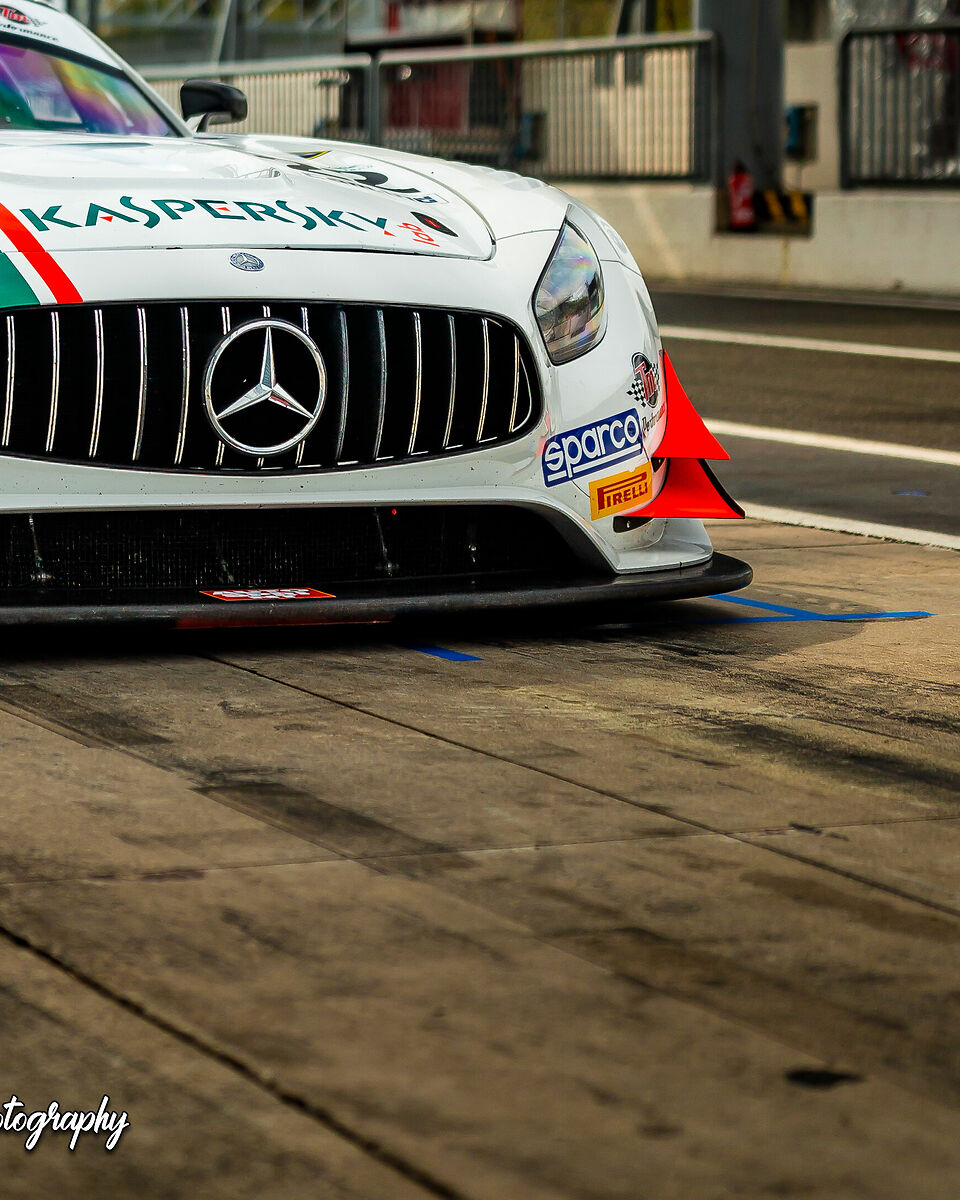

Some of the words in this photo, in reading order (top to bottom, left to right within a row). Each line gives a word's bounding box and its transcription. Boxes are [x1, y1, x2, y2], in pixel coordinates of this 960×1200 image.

[19, 195, 396, 237] KASPERSKY
[544, 414, 639, 478] sparco
[597, 471, 648, 511] PIRELLI
